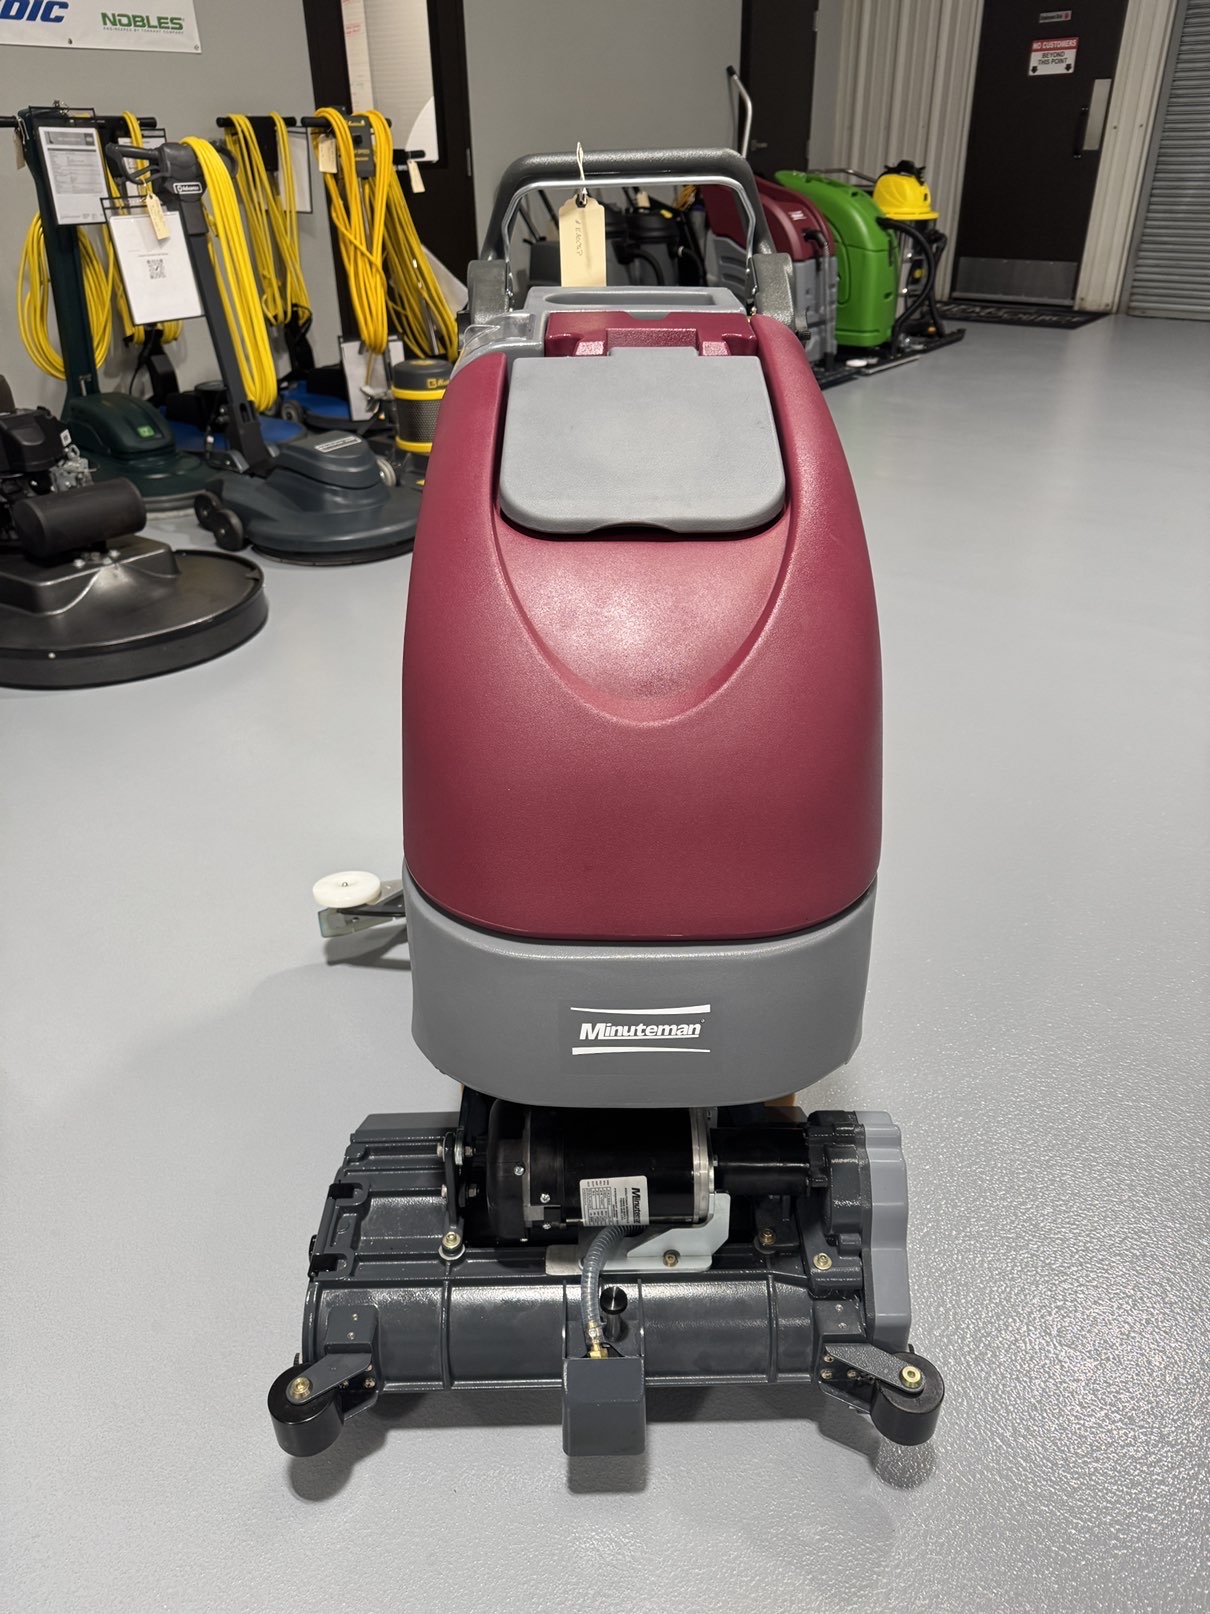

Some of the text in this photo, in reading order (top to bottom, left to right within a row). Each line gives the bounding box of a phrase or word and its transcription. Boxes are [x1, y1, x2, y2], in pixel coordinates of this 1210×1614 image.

[101, 12, 183, 30] NOBLES
[1042, 40, 1076, 48] CUSTOMERS
[579, 1022, 701, 1040] Minuteman
